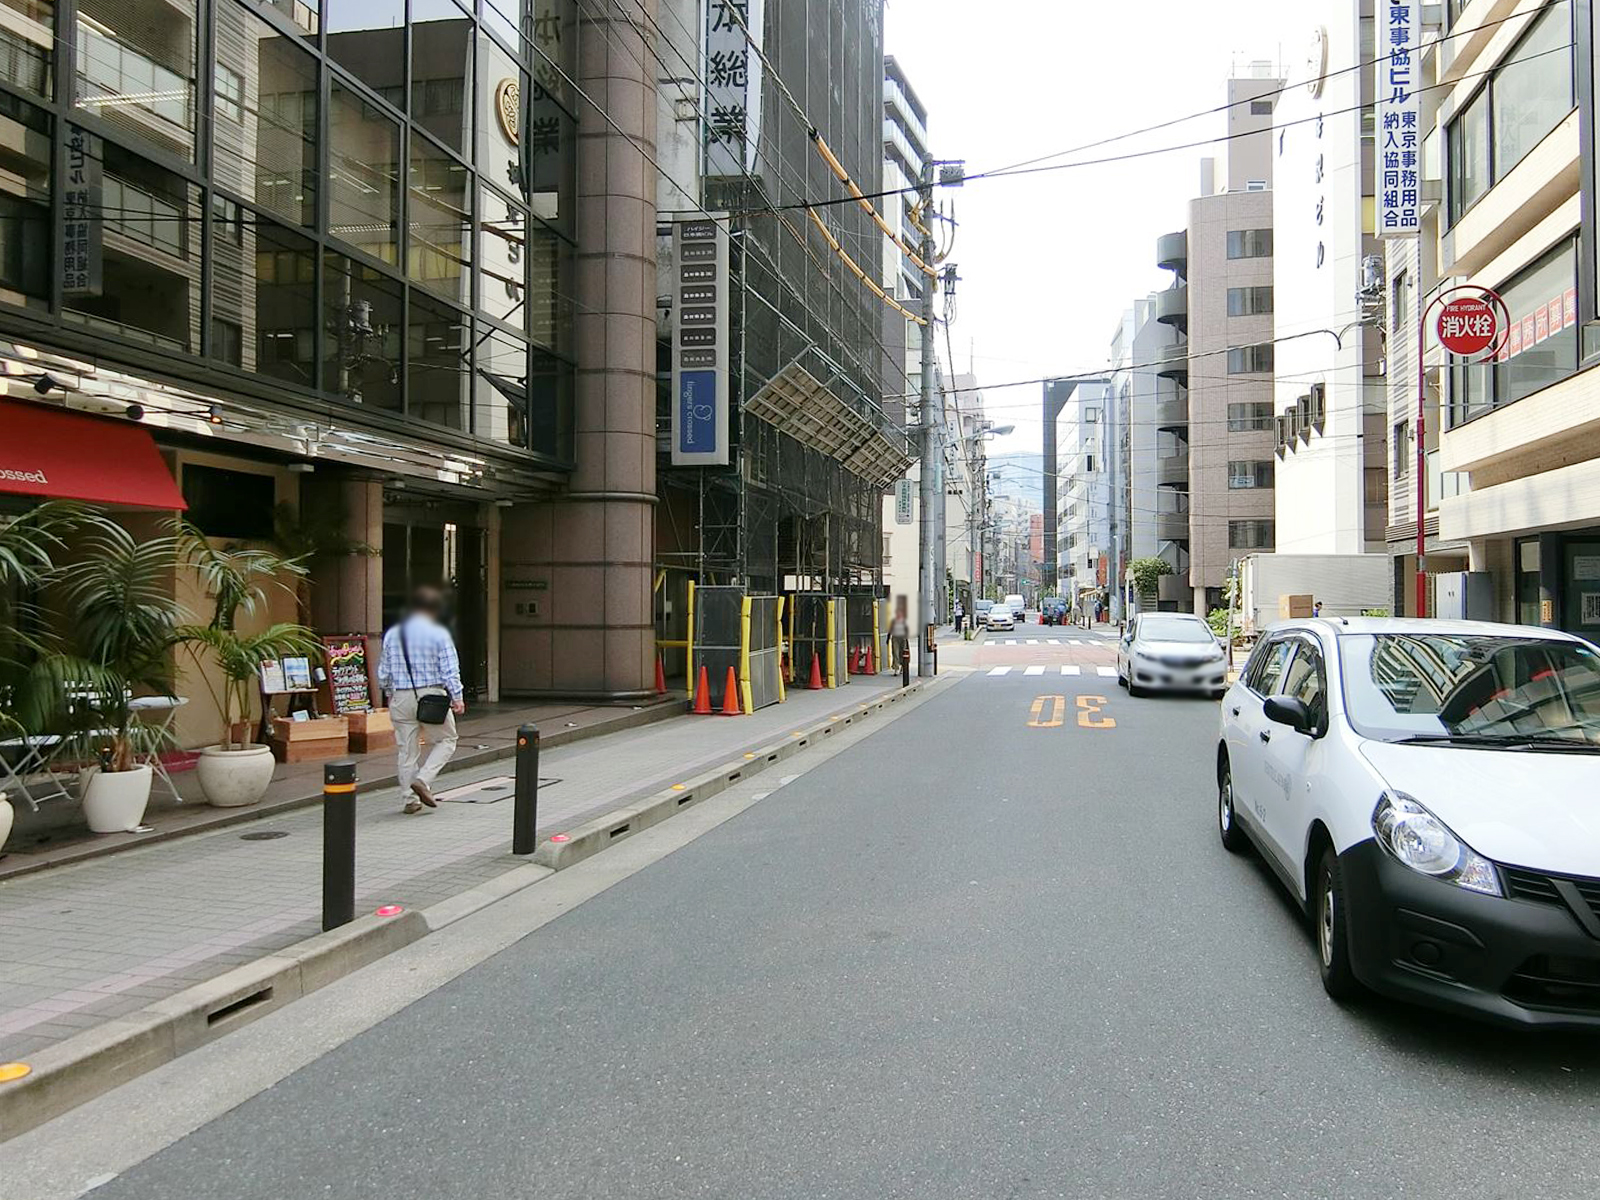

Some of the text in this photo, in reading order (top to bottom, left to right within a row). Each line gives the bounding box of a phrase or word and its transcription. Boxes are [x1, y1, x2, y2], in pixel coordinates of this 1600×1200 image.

[1389, 5, 1411, 104] 東事協ビル
[1383, 111, 1399, 228] 納入協同組合
[1401, 111, 1417, 227] 東京事務用品
[1442, 314, 1492, 338] 消火栓
[1446, 304, 1487, 312] FIRE HYDRANT
[1026, 695, 1117, 728] 30
